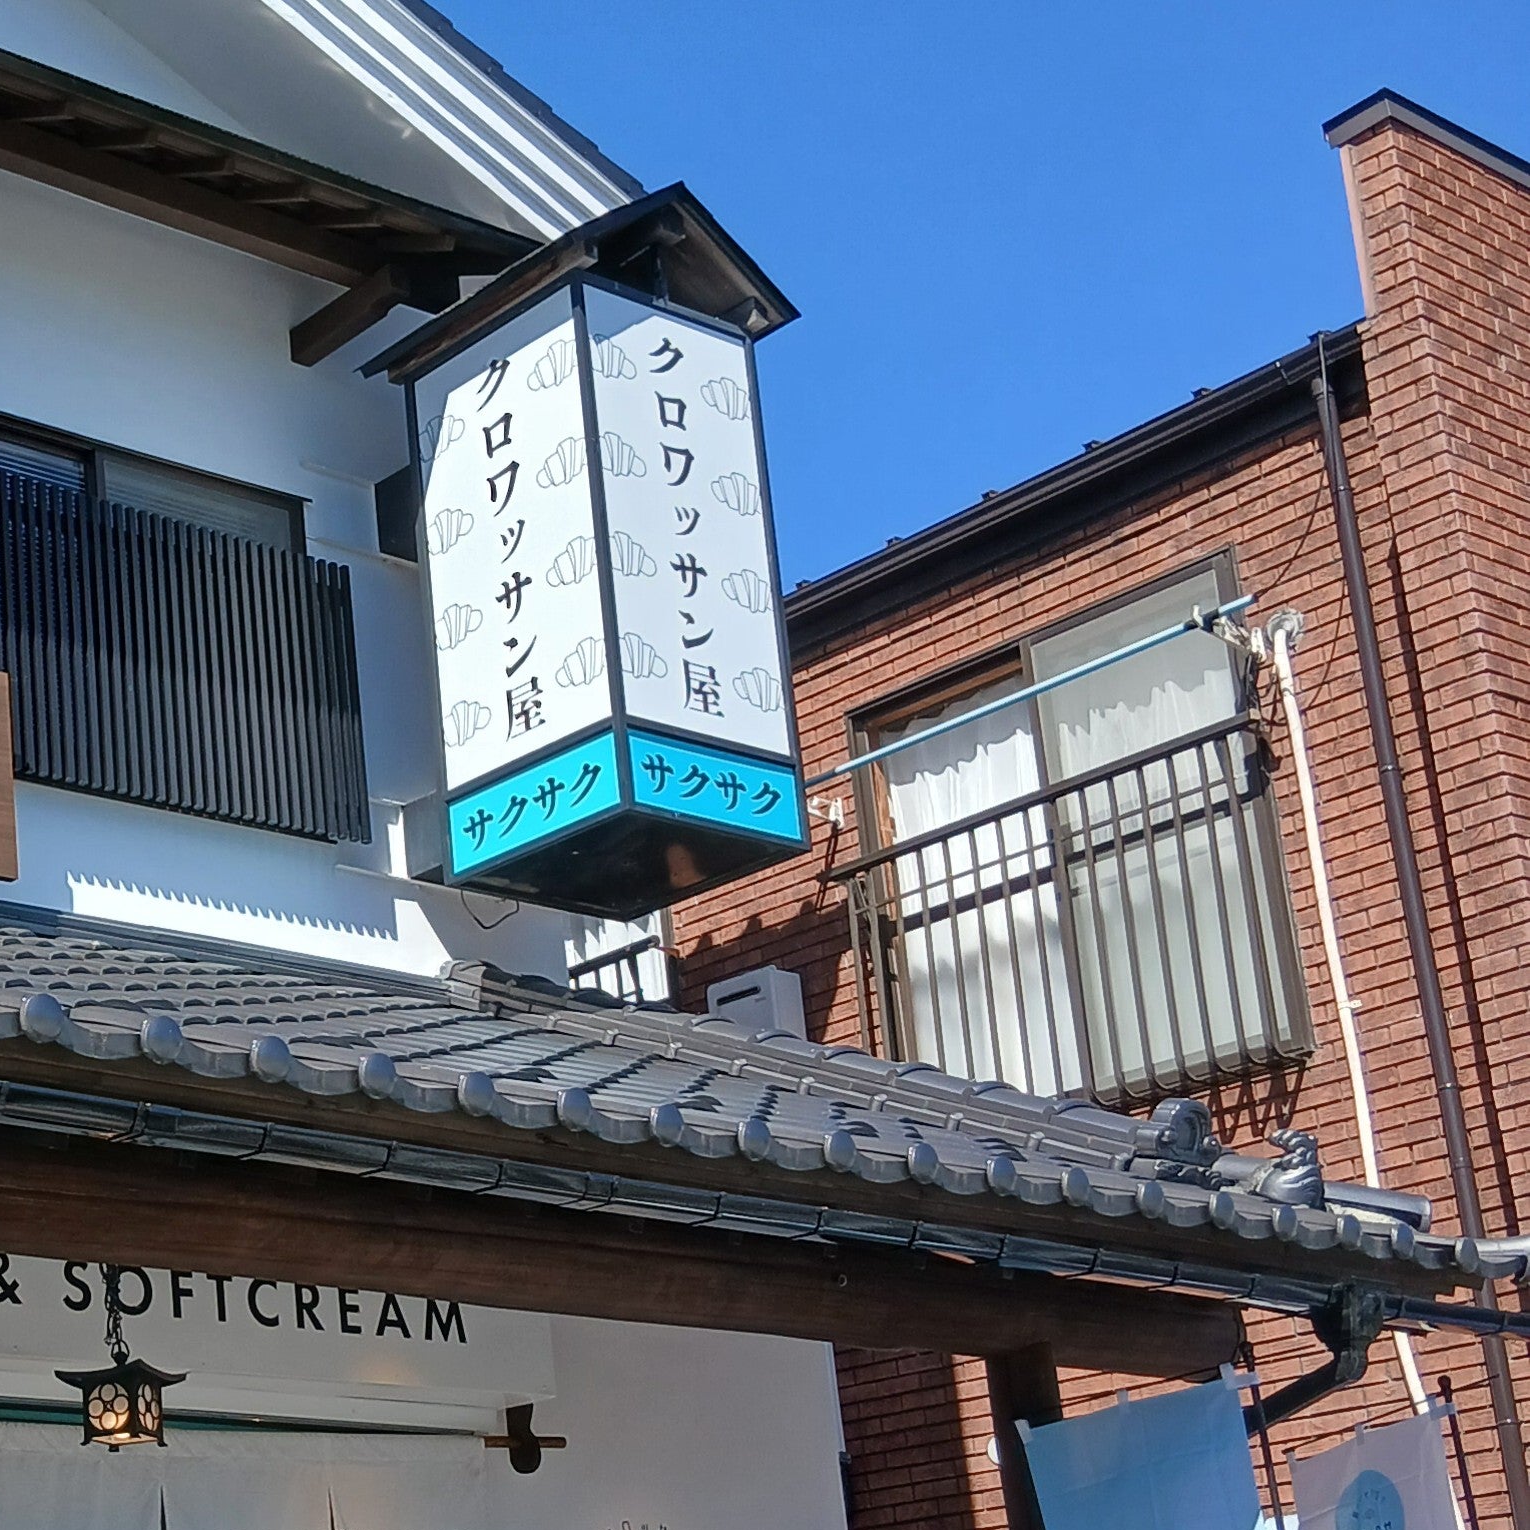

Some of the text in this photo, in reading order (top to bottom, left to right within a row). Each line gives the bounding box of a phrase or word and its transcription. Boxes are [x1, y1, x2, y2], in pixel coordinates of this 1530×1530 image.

[476, 357, 546, 742] クロワッサン屋
[648, 336, 726, 719] クロワッサン屋
[462, 761, 603, 851] サクサク
[640, 754, 783, 816] サクサク
[62, 1261, 468, 1345] SOFTCREAM
